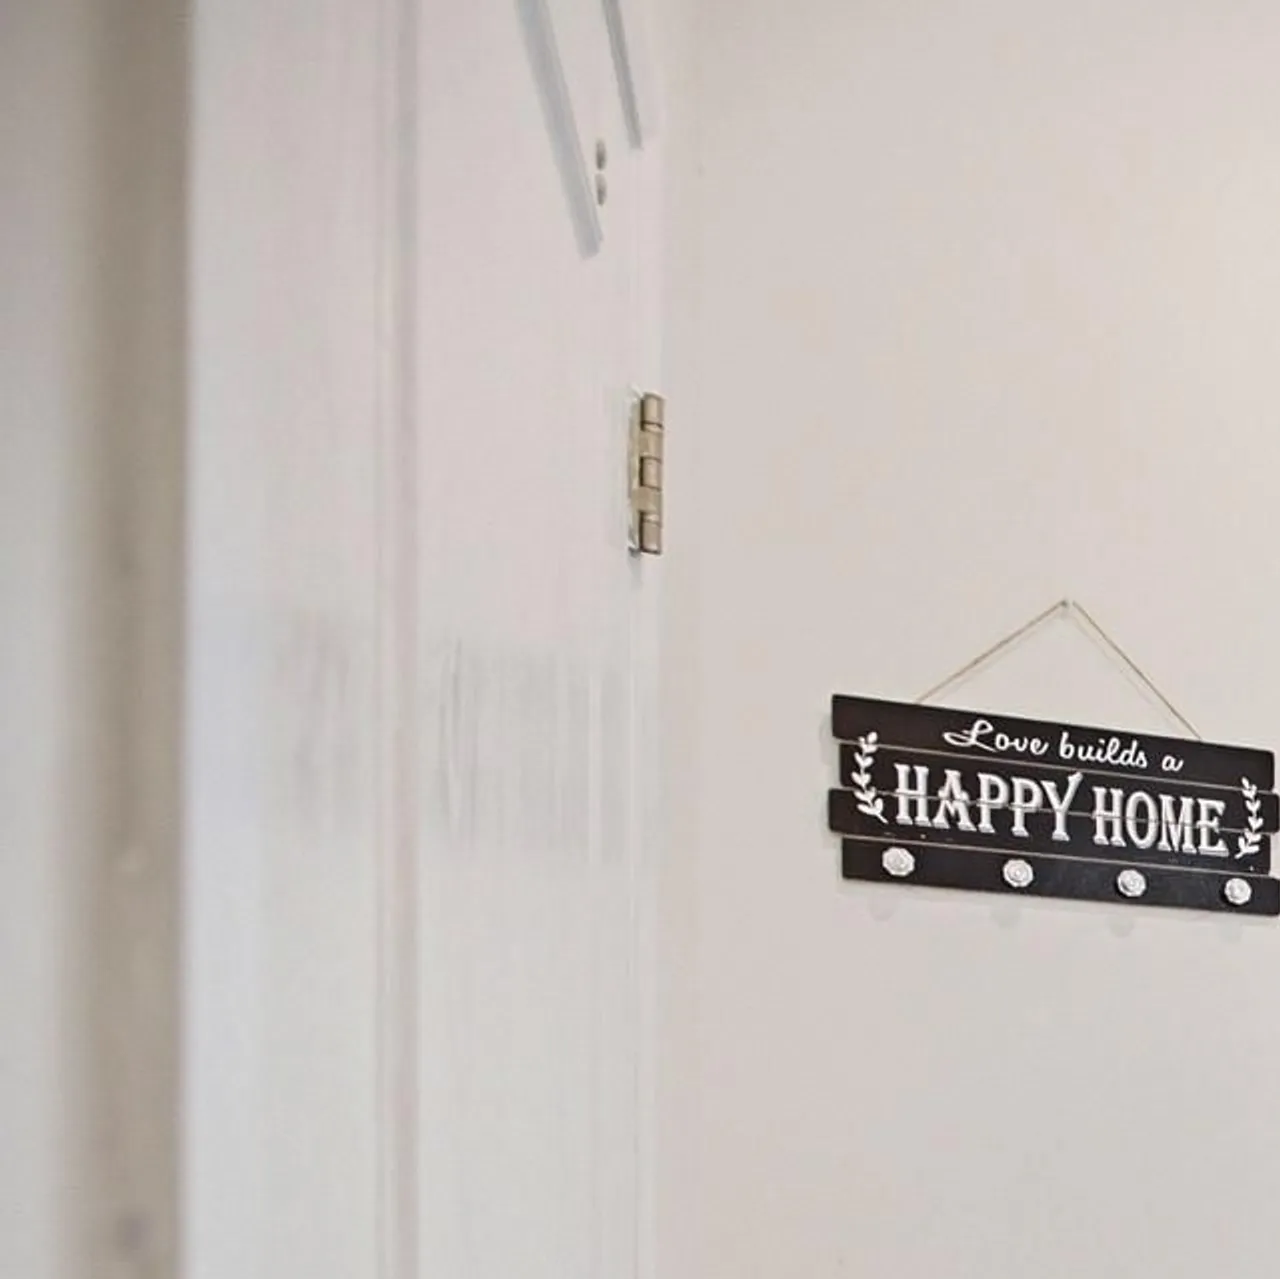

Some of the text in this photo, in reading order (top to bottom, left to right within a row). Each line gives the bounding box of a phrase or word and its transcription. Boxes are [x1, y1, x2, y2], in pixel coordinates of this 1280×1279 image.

[943, 719, 1184, 772] Love builds a
[893, 763, 1229, 858] HAPPY HOME
